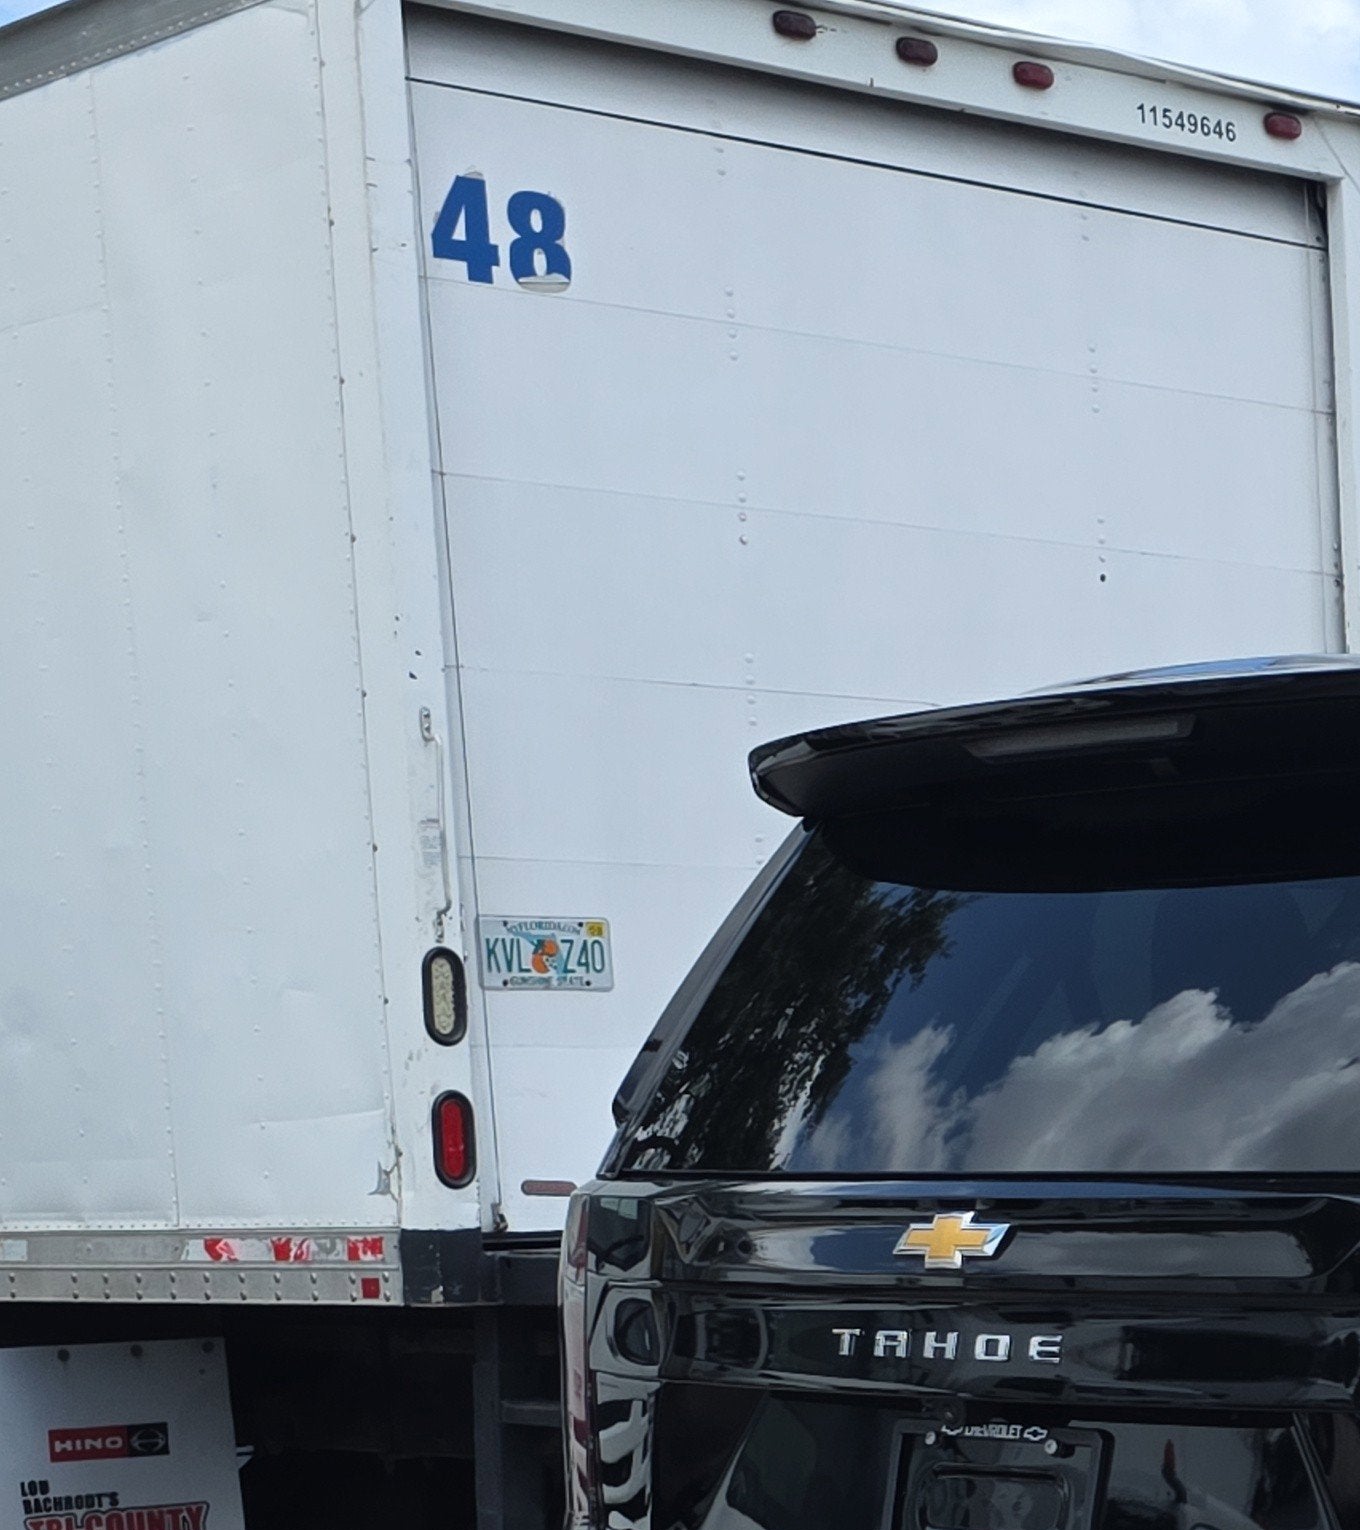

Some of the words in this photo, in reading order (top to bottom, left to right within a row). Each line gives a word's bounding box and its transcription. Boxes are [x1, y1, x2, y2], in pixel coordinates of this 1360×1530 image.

[1136, 102, 1238, 143] 11549646
[431, 174, 573, 290] 48
[485, 937, 532, 974] KVL
[560, 939, 606, 974] Z40
[832, 1327, 1065, 1364] TAHOE
[54, 1434, 124, 1452] HINO
[20, 1480, 49, 1497] LOU
